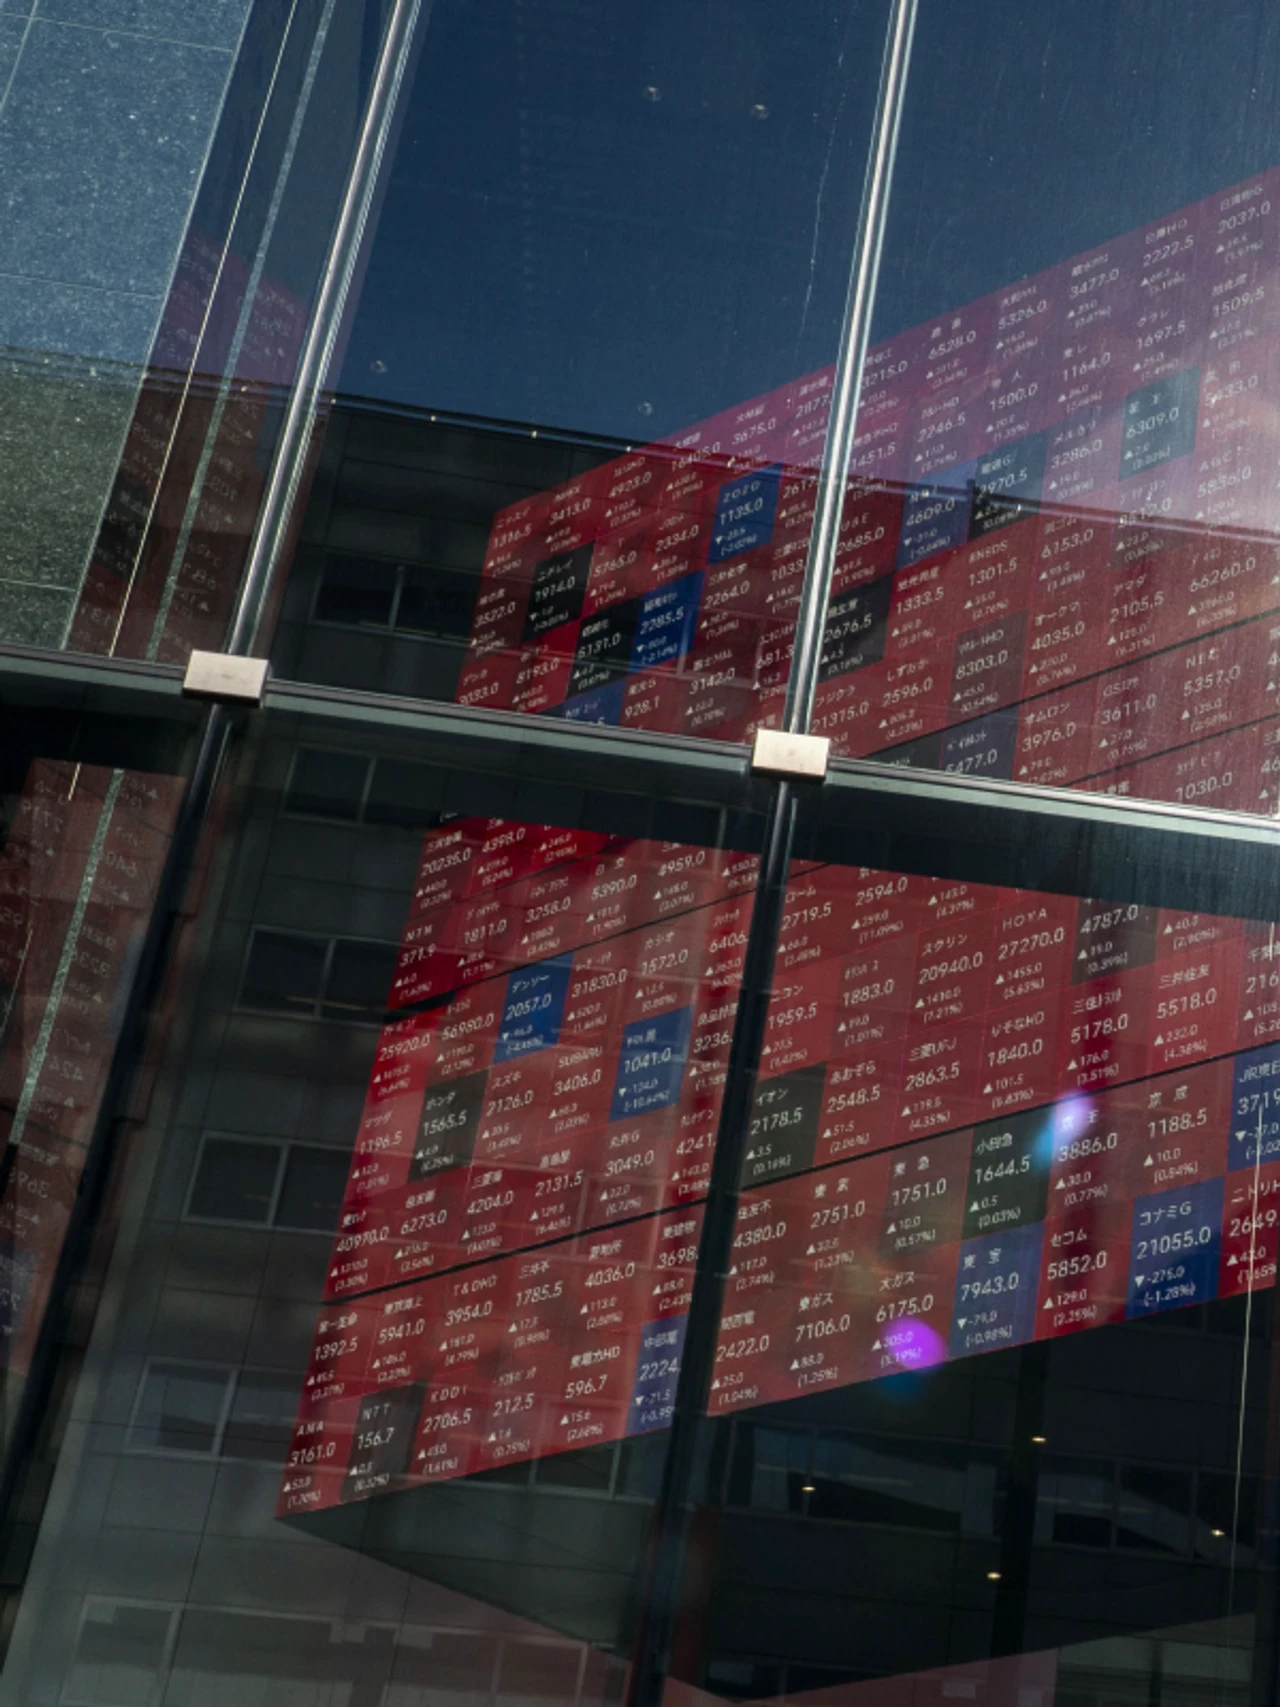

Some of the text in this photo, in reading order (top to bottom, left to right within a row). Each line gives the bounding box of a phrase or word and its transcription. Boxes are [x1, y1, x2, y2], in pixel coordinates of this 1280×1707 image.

[856, 876, 908, 906] 2594.0
[781, 902, 831, 931] 2719.5
[1081, 904, 1138, 933] 4787.0
[919, 952, 983, 984] 20940.0
[844, 979, 894, 1006] 1883.0
[1157, 988, 1217, 1018] 5518.0
[769, 1002, 817, 1029] 1959.5
[1071, 1013, 1128, 1043] 5178.0
[988, 1038, 1043, 1066] 1840.0
[905, 1061, 959, 1091] 2863.5
[487, 1090, 533, 1116] 2126.0
[828, 1084, 880, 1112] 2548.5
[751, 1107, 802, 1135] 2178.5
[1148, 1108, 1207, 1137] 1188.5
[605, 1150, 654, 1176] 3049.0
[976, 1155, 1030, 1183] 1644.5
[893, 1178, 946, 1205] 1751.0
[811, 1200, 865, 1228] 2751.0
[733, 1222, 786, 1247] 4380.0
[1137, 1226, 1211, 1259] 21055.0
[585, 1262, 635, 1287] 4036.0
[1048, 1251, 1107, 1280] 5852.0
[517, 1281, 562, 1306] 1785.5
[962, 1272, 1019, 1300] 7943.0
[445, 1300, 492, 1326] 3954.0
[876, 1294, 933, 1322] 6175.0
[796, 1314, 850, 1342] 7106.0
[316, 1337, 357, 1360] 1392.5
[716, 1335, 769, 1362] 2422.0
[493, 1393, 534, 1416] 212.5
[423, 1408, 472, 1433] 2706.5
[359, 1427, 394, 1449] 156.7
[289, 1442, 336, 1467] 3161.0
